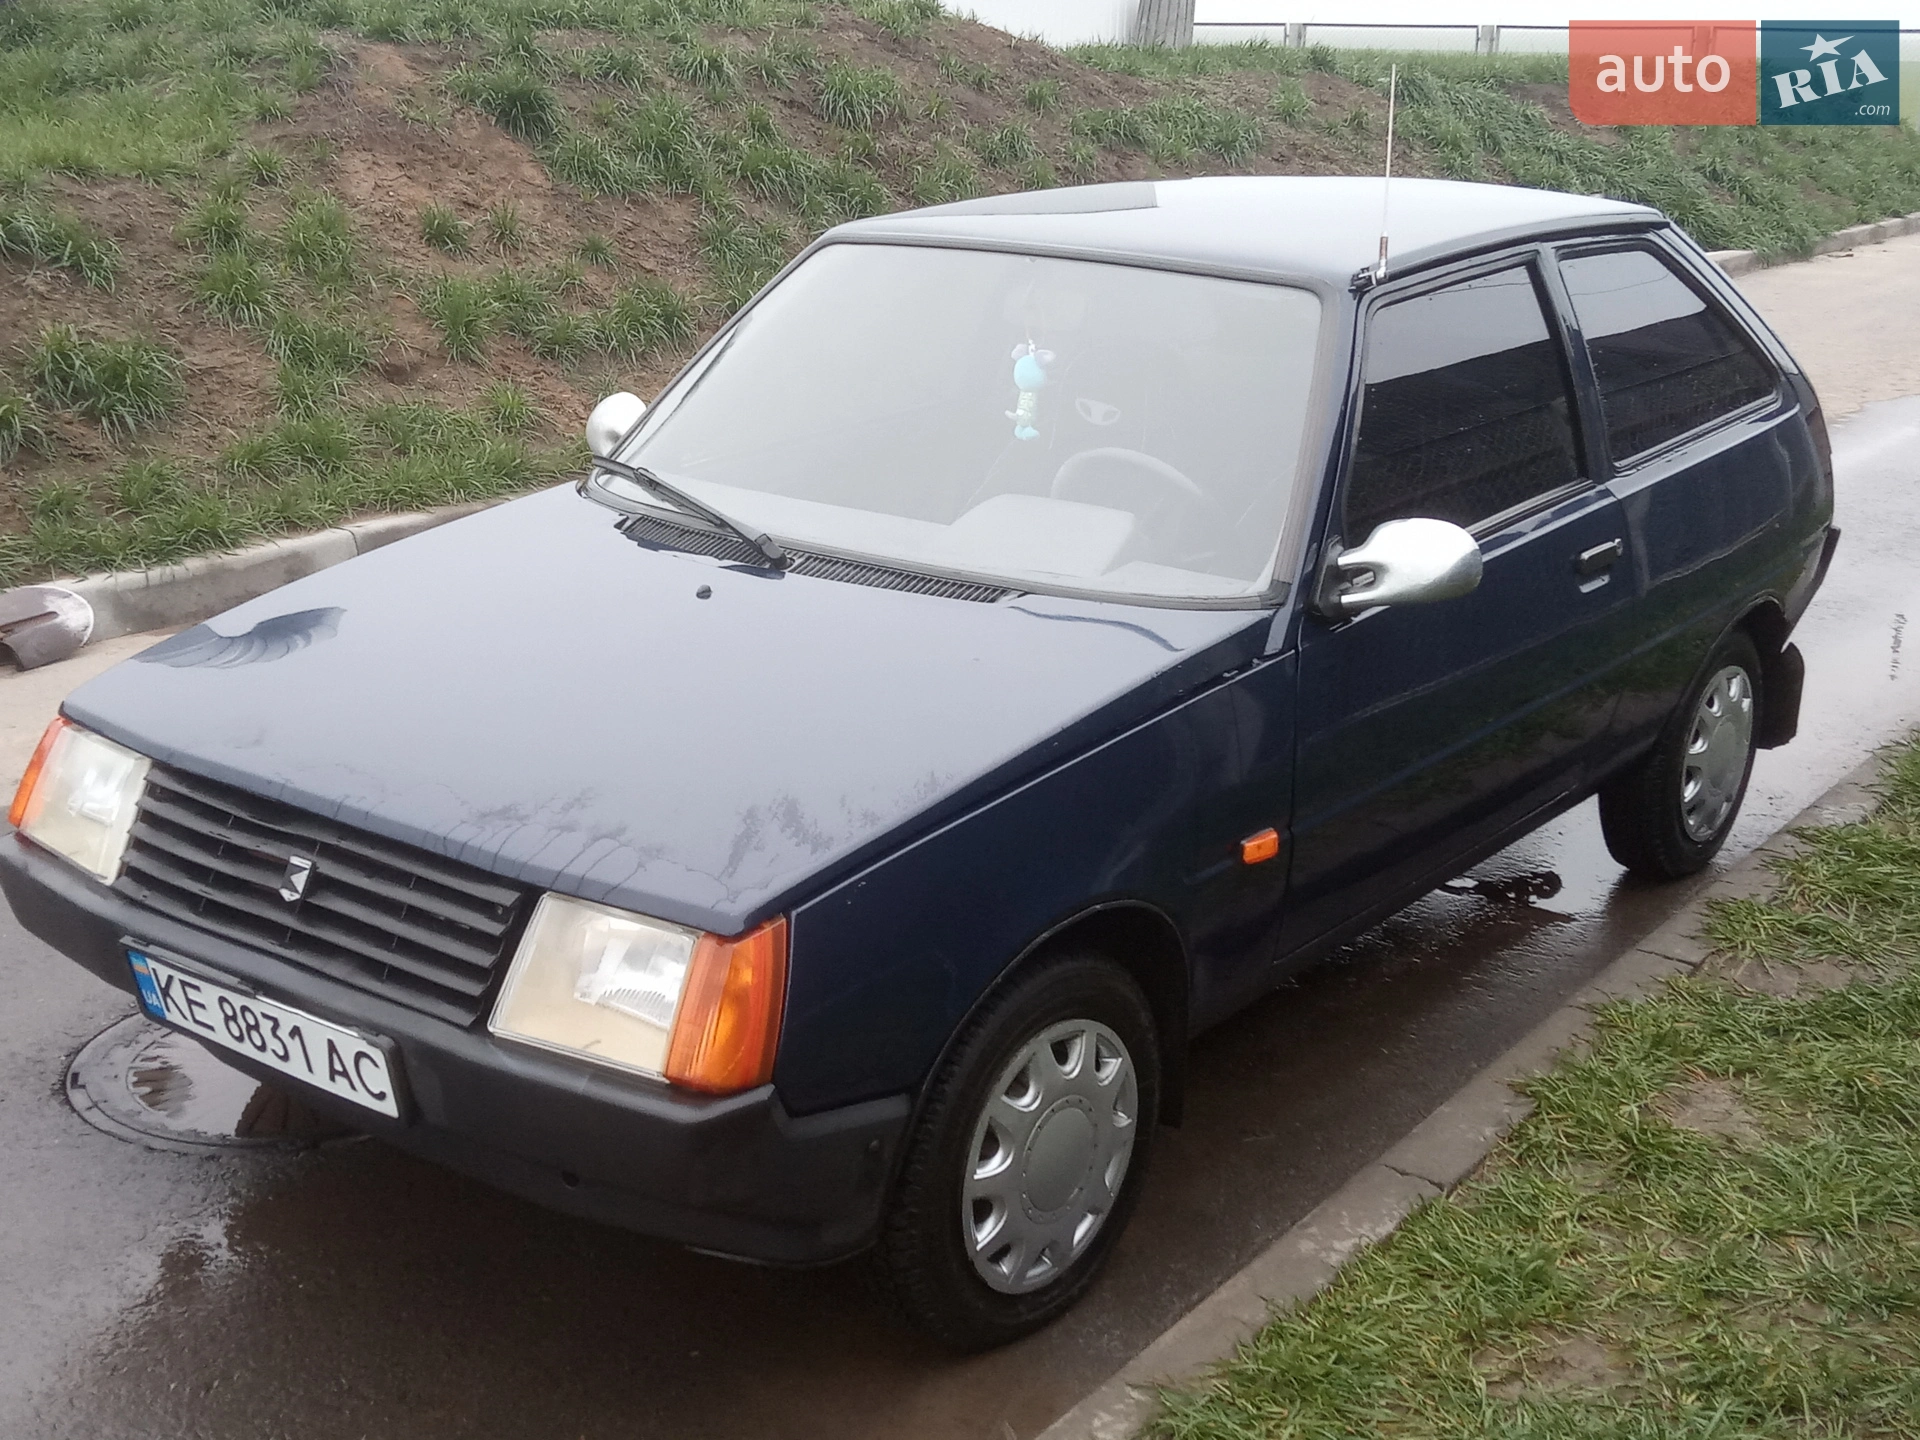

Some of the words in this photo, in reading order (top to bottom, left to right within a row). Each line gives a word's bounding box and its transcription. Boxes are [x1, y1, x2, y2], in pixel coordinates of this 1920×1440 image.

[152, 967, 216, 1032] KE
[218, 995, 314, 1074] 8831
[327, 1038, 387, 1101] AC
